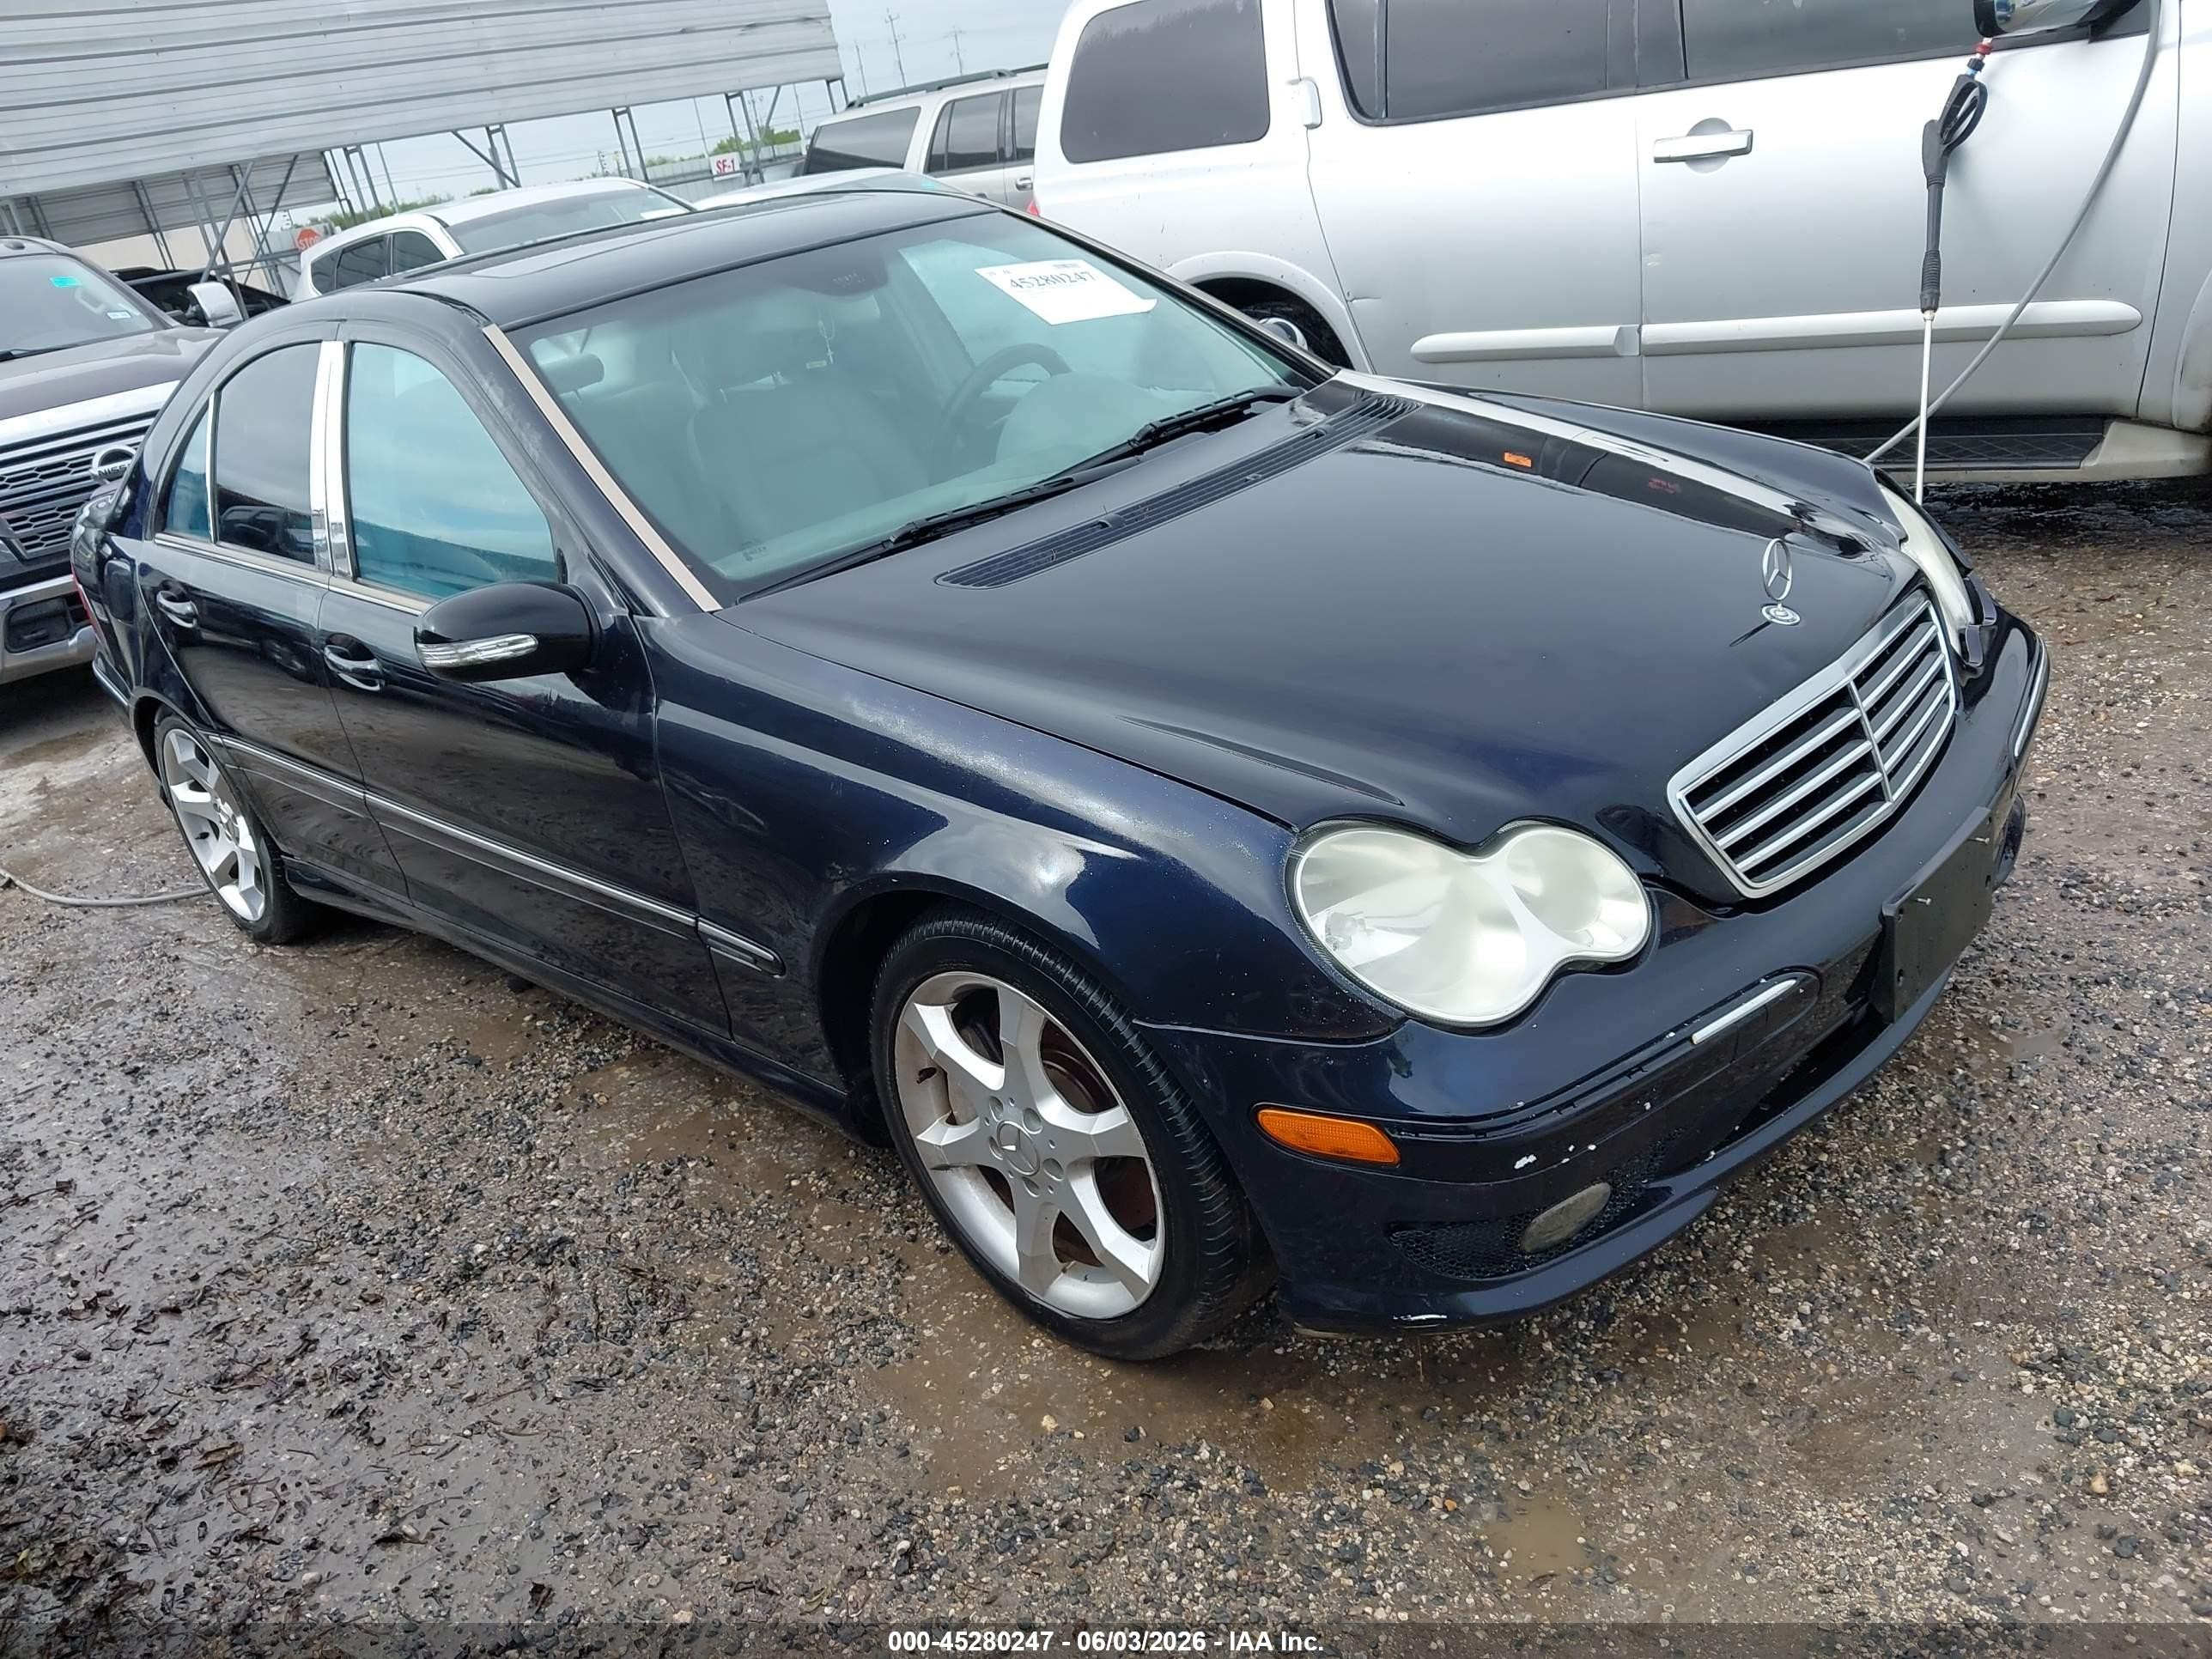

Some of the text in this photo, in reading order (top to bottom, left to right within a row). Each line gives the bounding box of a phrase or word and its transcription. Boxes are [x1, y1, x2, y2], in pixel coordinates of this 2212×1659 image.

[715, 158, 736, 174] SF-1
[1009, 270, 1098, 289] 45280247
[98, 464, 130, 477] NISS
